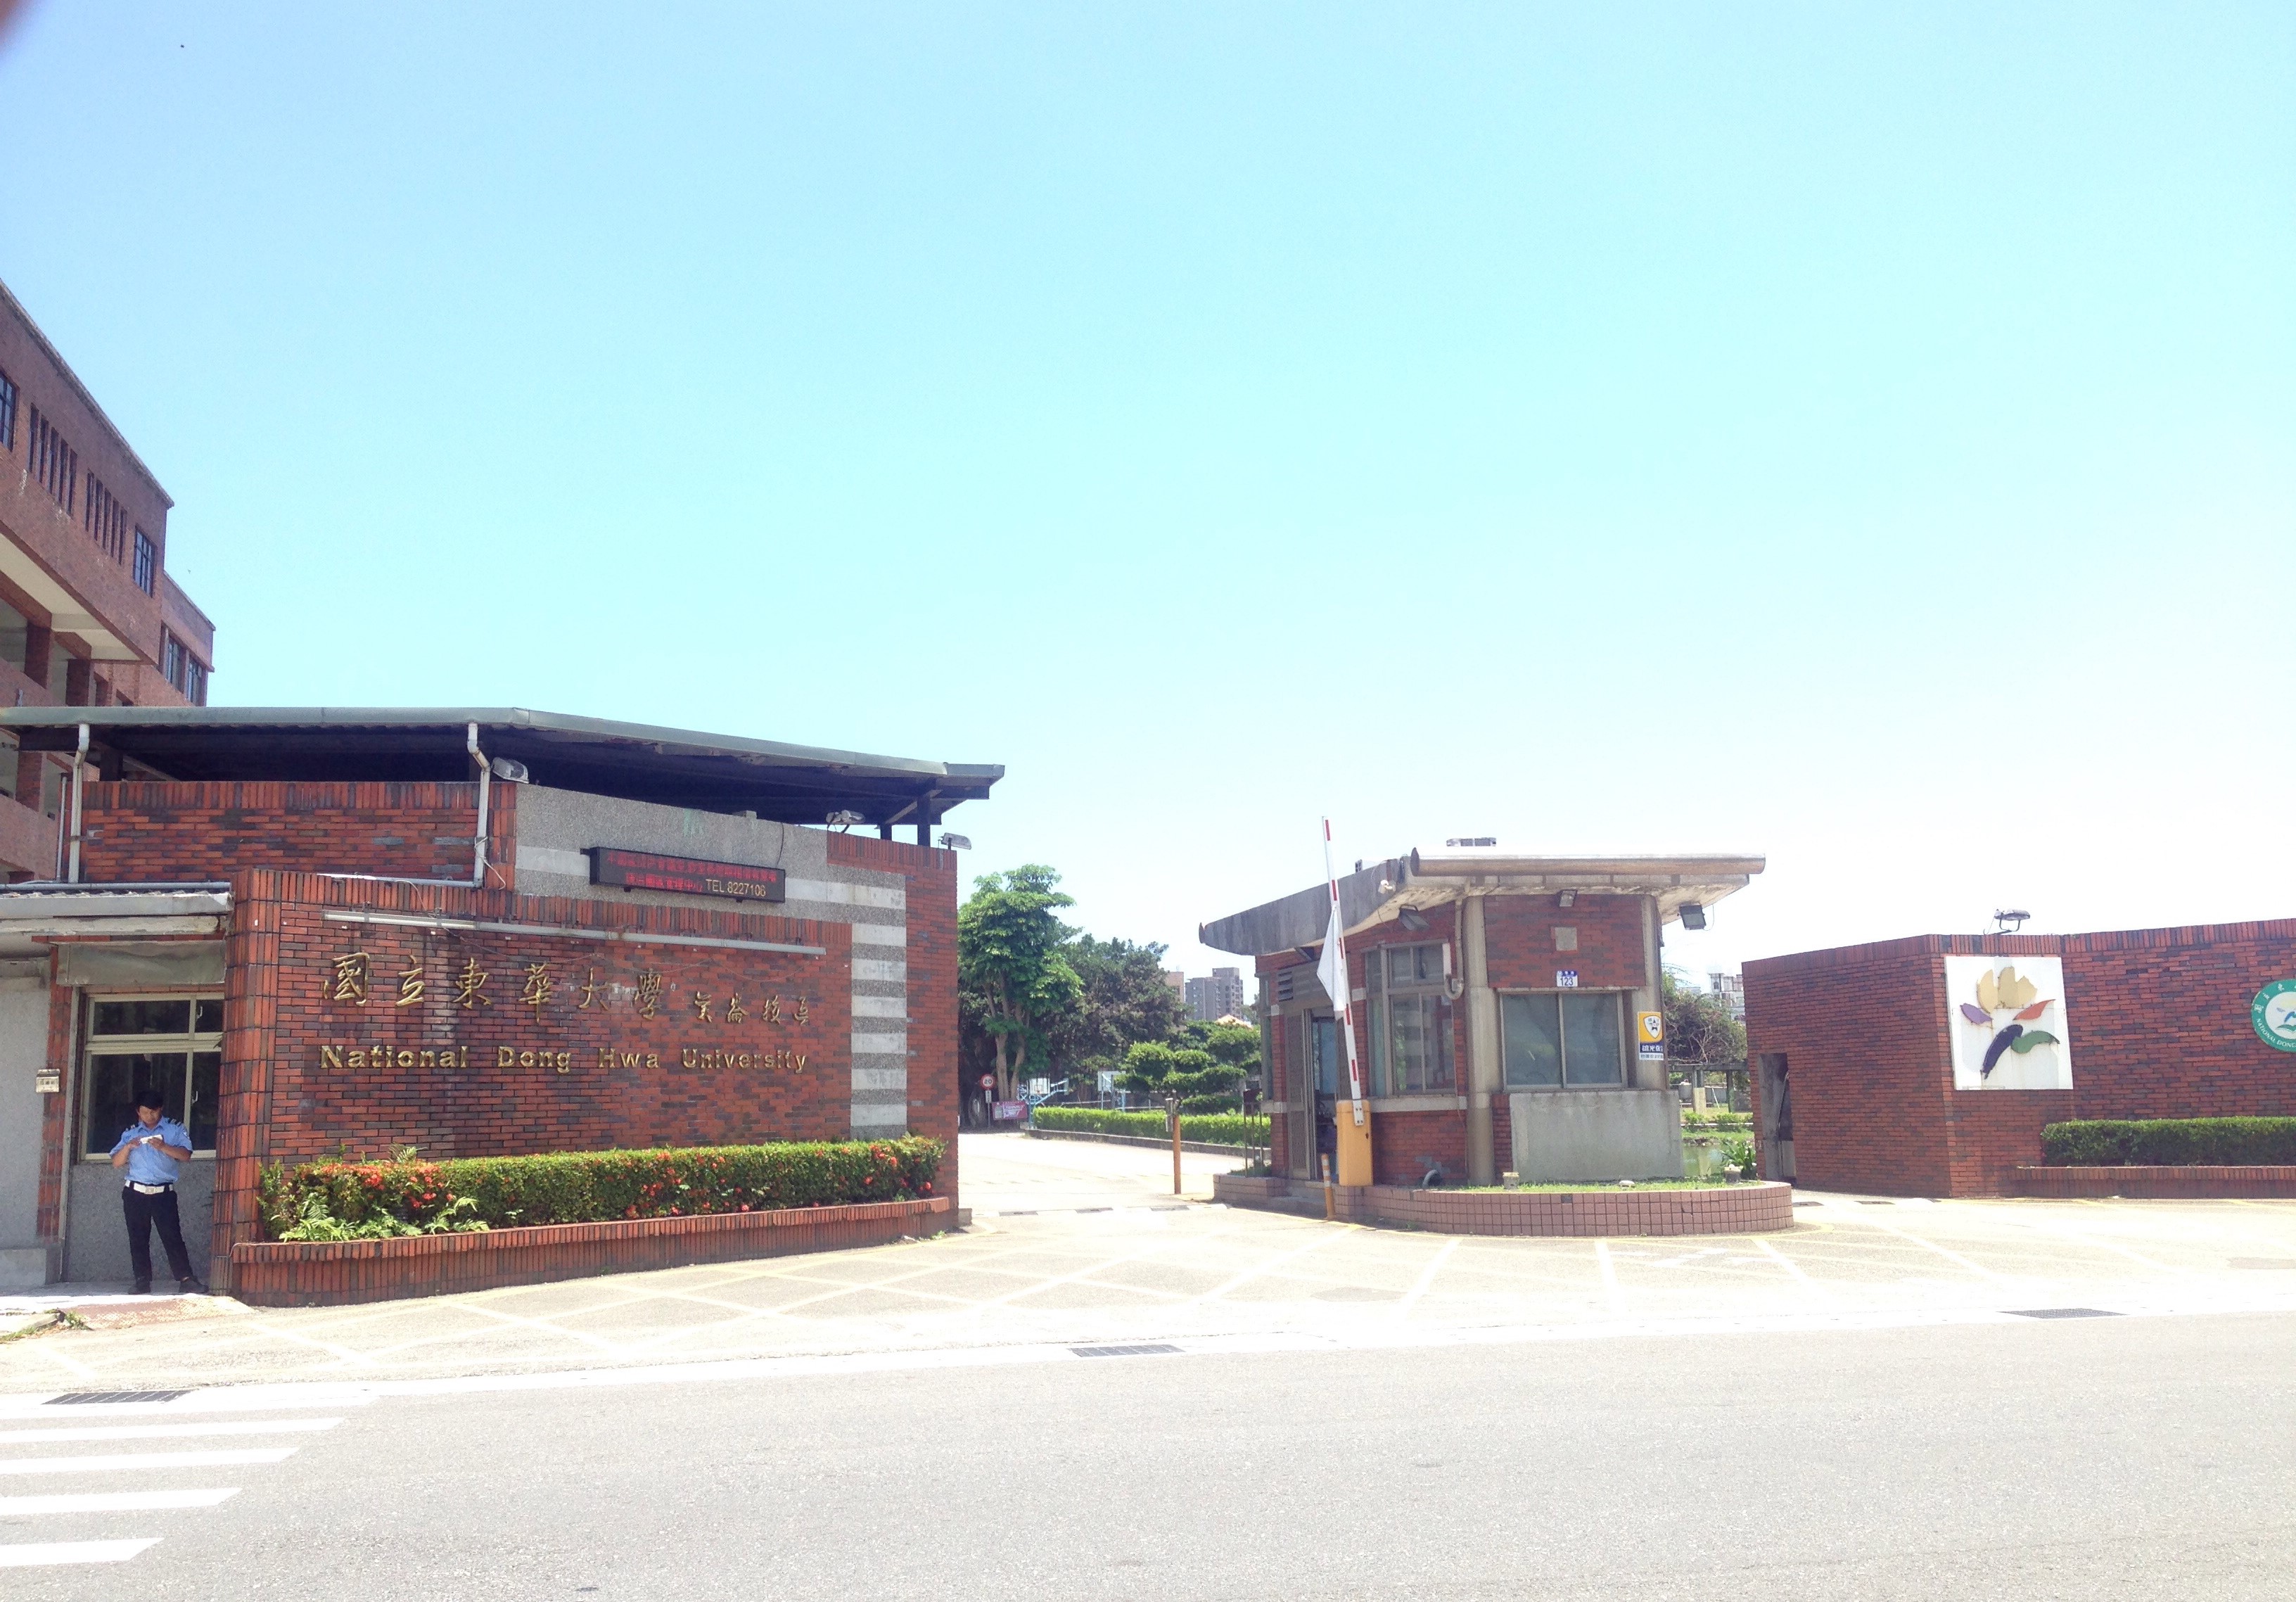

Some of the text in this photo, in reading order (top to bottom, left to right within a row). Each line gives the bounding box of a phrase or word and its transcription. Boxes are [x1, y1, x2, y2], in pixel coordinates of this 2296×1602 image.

[1560, 977, 1573, 986] 123
[2257, 1018, 2276, 1043] NATIONAL
[319, 1045, 806, 1074] National Dong Hwa University
